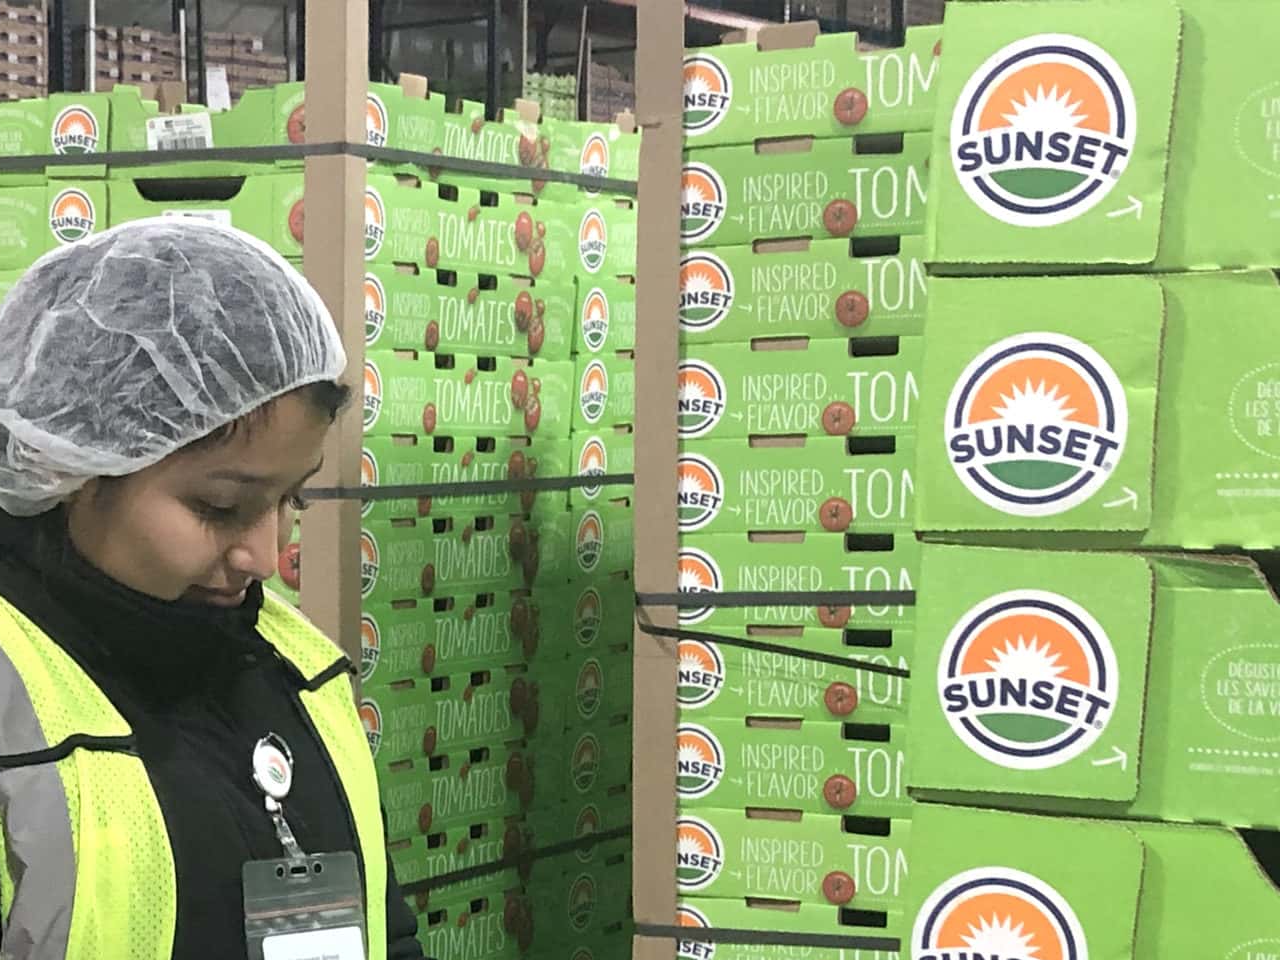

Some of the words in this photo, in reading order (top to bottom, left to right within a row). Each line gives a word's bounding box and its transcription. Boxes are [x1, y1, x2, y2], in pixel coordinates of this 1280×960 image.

[749, 61, 836, 94] INSPIRED
[684, 92, 729, 109] NSET
[753, 92, 830, 123] FLAVOR
[54, 135, 98, 149] SUNSET
[368, 130, 385, 147] SET
[444, 121, 520, 166] TOMATOES
[957, 130, 1129, 176] SUNSET
[743, 171, 829, 203] INSPIRED
[51, 217, 94, 231] SUNSET
[681, 203, 724, 219] NSET
[747, 203, 823, 233] FLAVOR
[437, 211, 516, 266] TOMATES
[751, 263, 837, 293] INSPIRED
[437, 295, 516, 345] TOMATES
[757, 293, 832, 323] FLAVOR
[365, 395, 381, 409] SET
[433, 378, 512, 425] TOMATES
[742, 373, 827, 402] INSPIRED
[678, 399, 723, 415] NSET
[747, 403, 820, 432] FLAVOR
[950, 423, 1119, 469] SUNSET
[739, 468, 824, 498] INSPIRED
[678, 492, 722, 510] NSET
[744, 498, 817, 526] FLAVOR
[432, 534, 511, 582] TOMATOES
[738, 565, 823, 593] INSPIRED
[435, 611, 511, 660] TOMATOES
[678, 671, 723, 688] NSET
[741, 651, 827, 680] INSPIRED
[747, 680, 820, 709] FLAVOR
[943, 677, 1111, 728] SUNSET
[1245, 680, 1280, 698] SAVE
[436, 690, 511, 742] TOMATOES
[1247, 698, 1265, 716] LA
[678, 760, 723, 779] NSET
[741, 743, 825, 772] INSPIRED
[431, 766, 507, 818] TOMATOES
[746, 771, 819, 800] FLAVOR
[677, 853, 721, 872] NSET
[740, 836, 824, 866] INSPIRED
[745, 866, 818, 895] FLAVOR
[678, 940, 713, 960] SET
